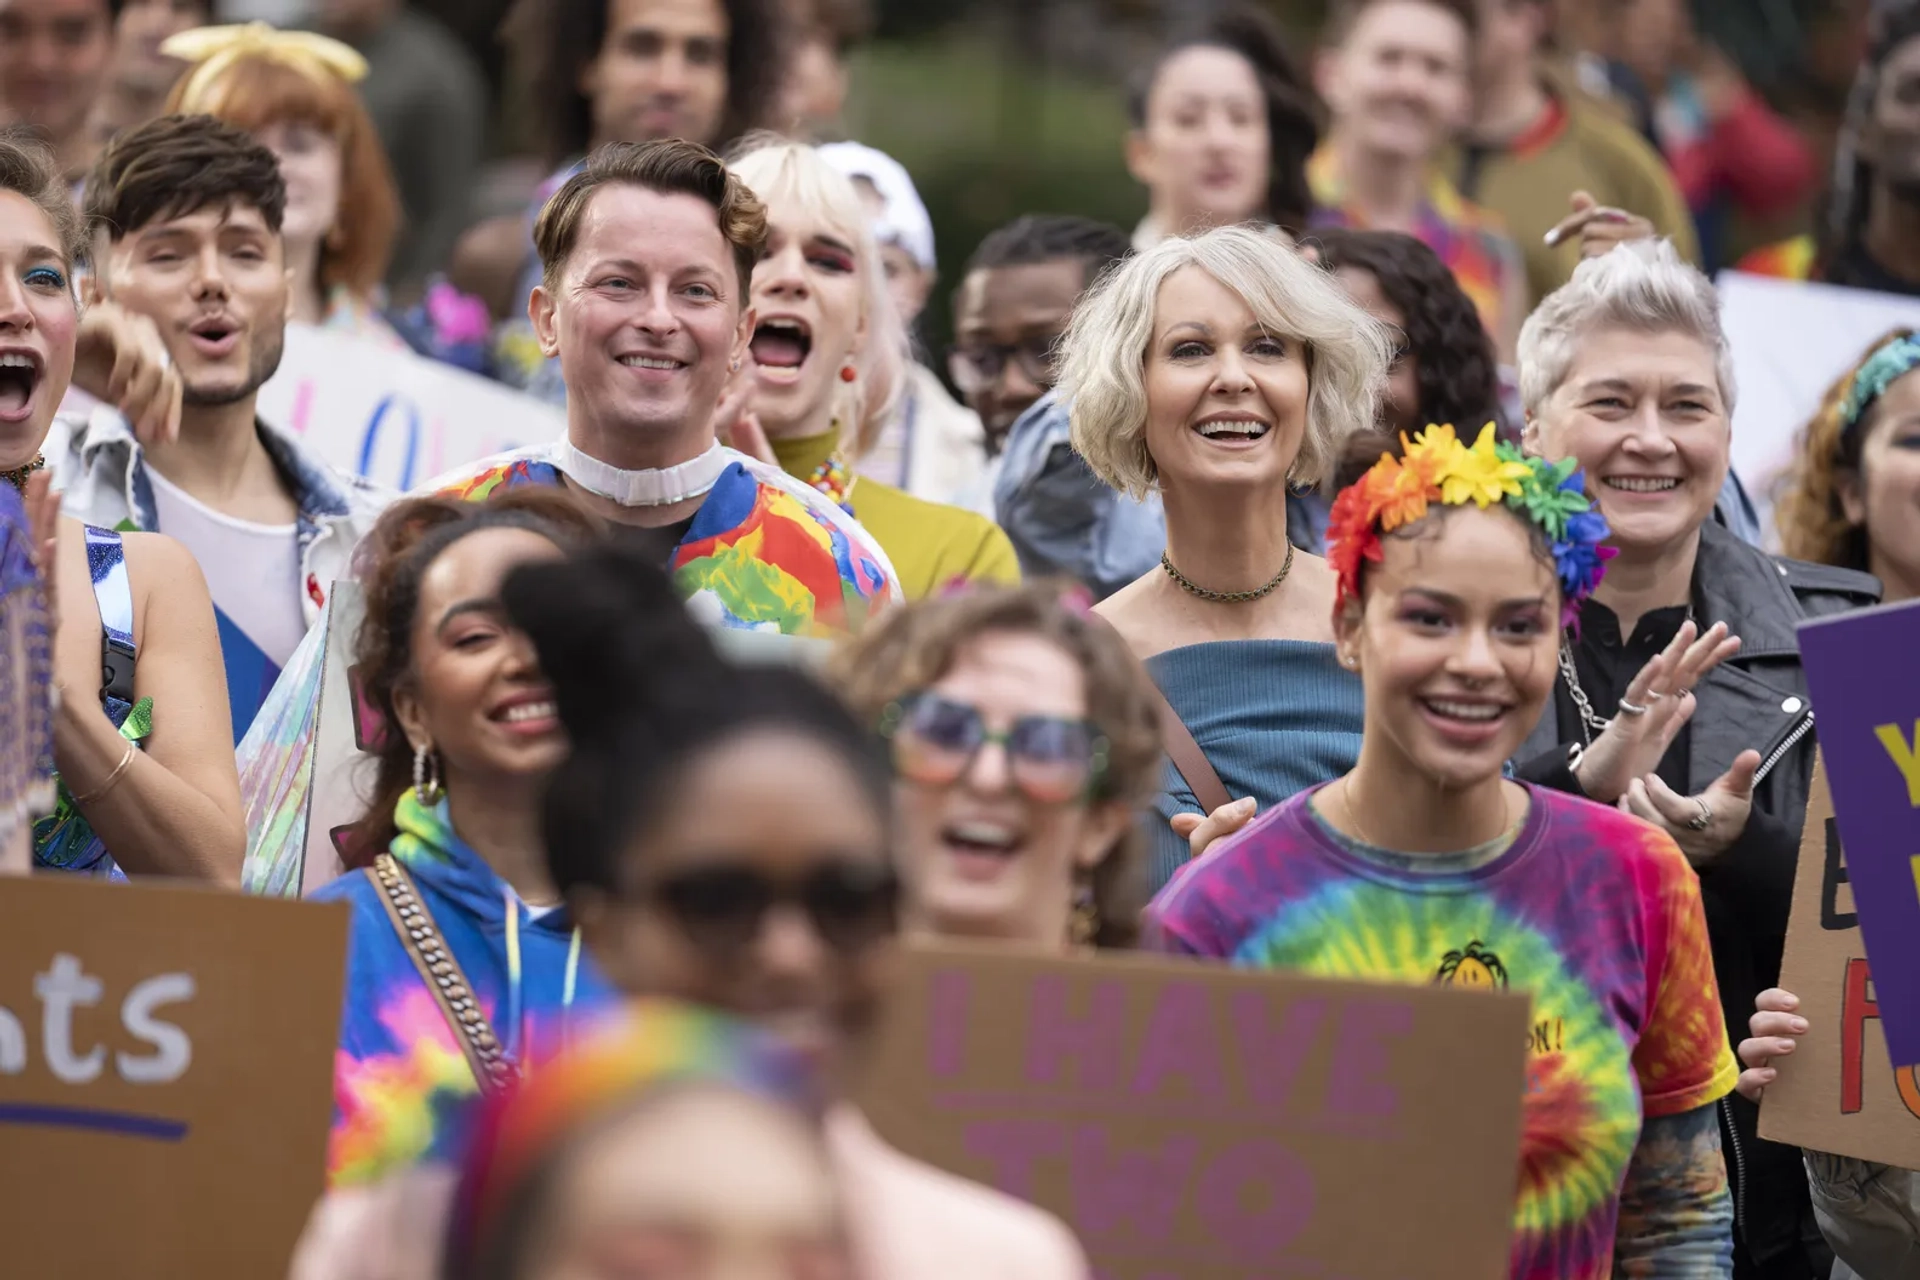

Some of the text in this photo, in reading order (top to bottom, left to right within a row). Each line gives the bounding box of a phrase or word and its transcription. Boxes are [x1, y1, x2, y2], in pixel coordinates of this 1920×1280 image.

[928, 968, 1416, 1117] I HAVE
[963, 1117, 1318, 1260] TWO
